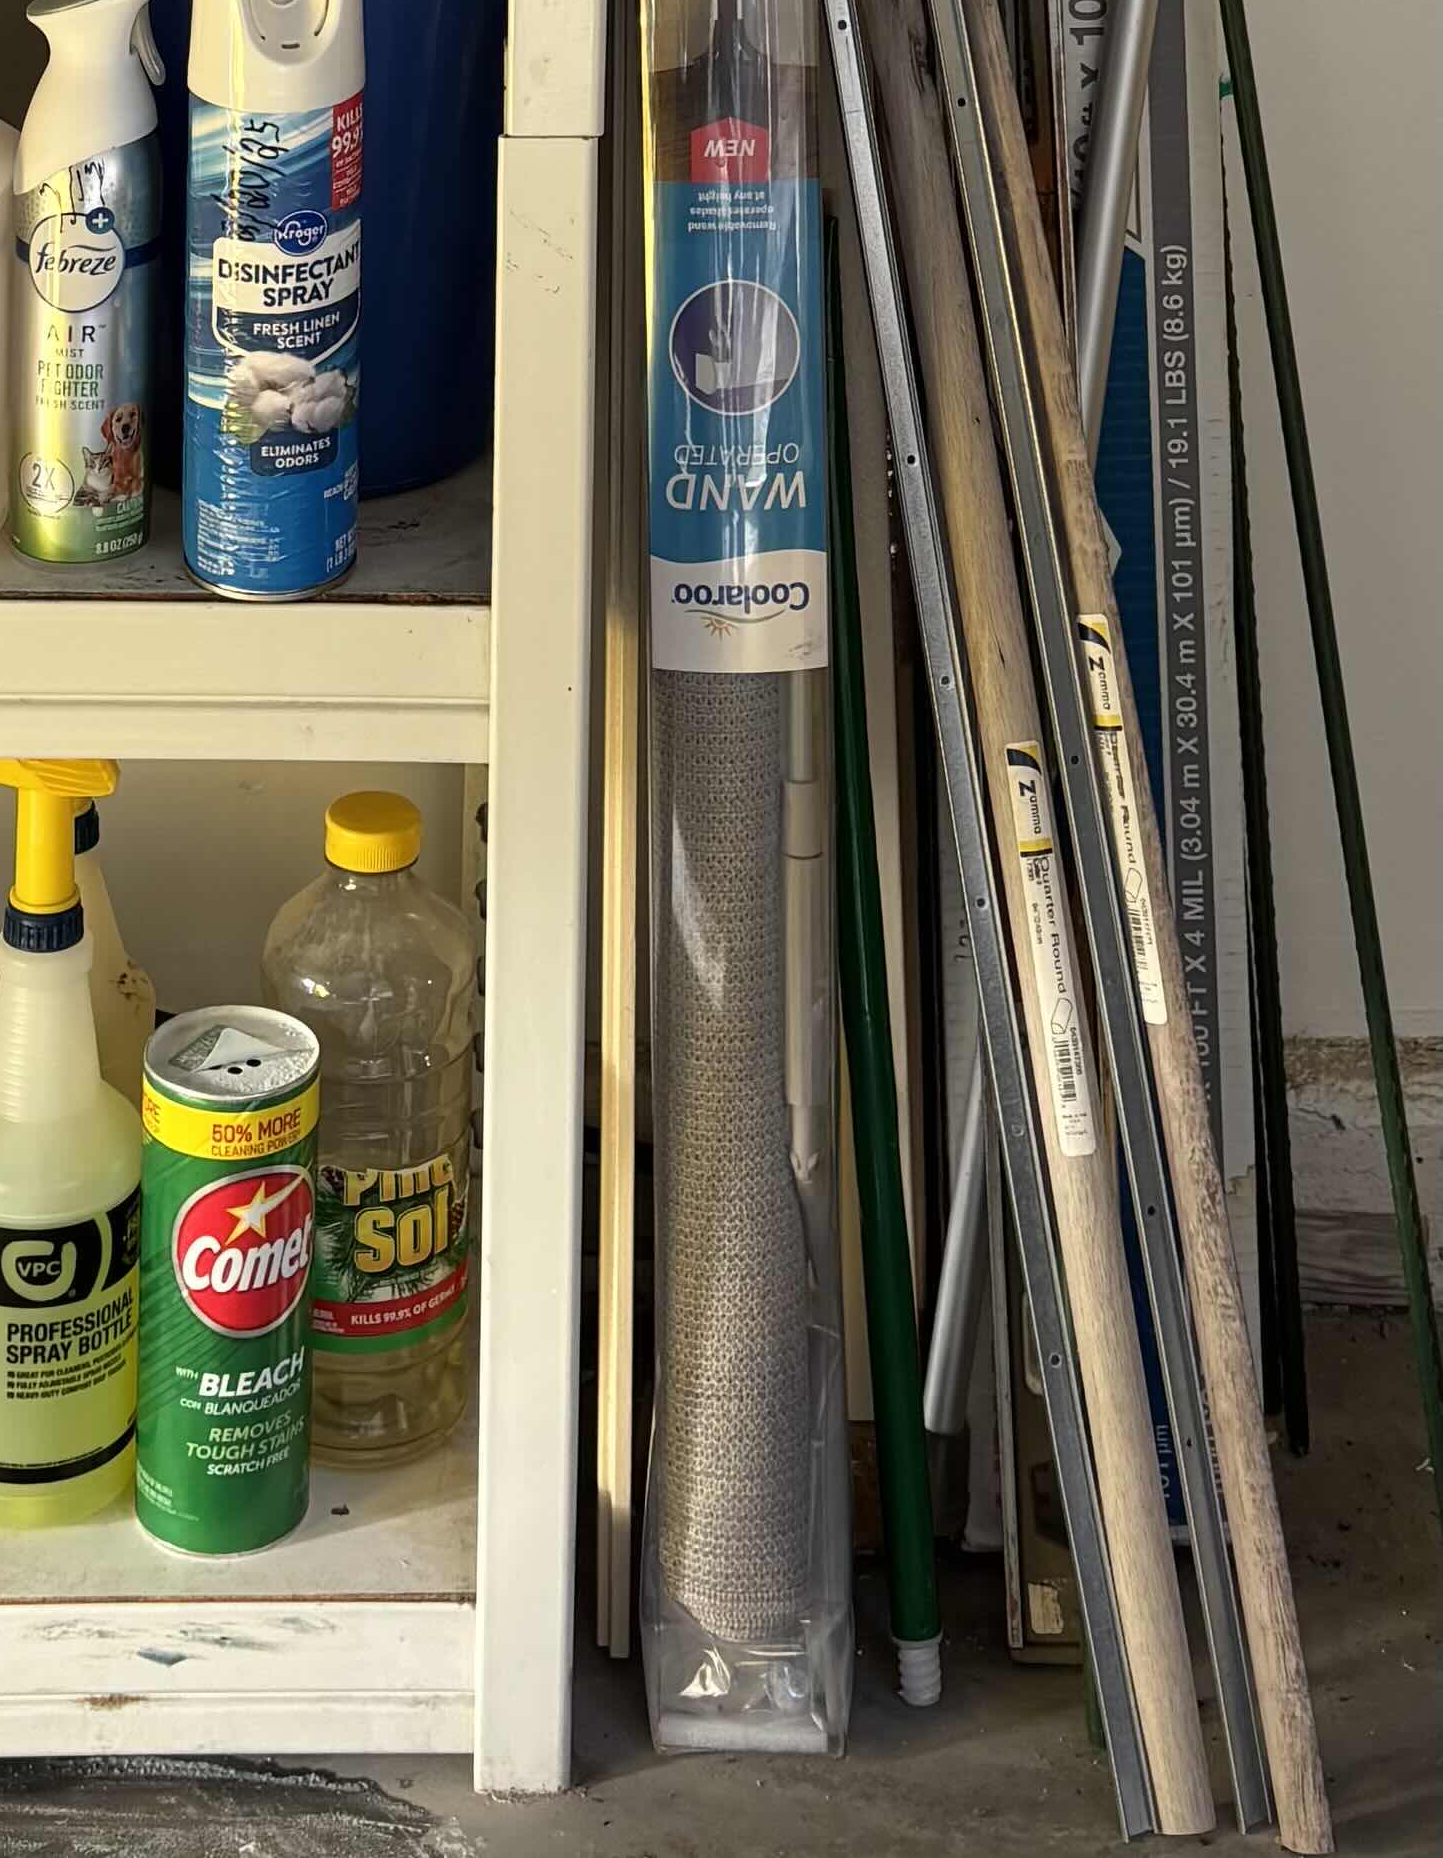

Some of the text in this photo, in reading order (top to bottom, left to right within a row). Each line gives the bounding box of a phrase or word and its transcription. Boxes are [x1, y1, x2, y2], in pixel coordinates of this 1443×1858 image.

[704, 139, 755, 158] NEW
[276, 219, 325, 247] Kroger
[35, 241, 117, 276] febreze
[1162, 241, 1187, 284] kg)
[262, 279, 334, 308] SPRAY
[47, 324, 97, 344] AIR
[252, 310, 340, 337] FRESH LINEN
[1166, 292, 1190, 344] (8.6
[276, 331, 322, 350] SCENT
[65, 363, 104, 381] ODOR
[1165, 350, 1187, 405] LBS
[261, 436, 331, 457] ELIMINATES
[1168, 417, 1189, 458] 19.1
[274, 453, 319, 469] ODORS
[674, 442, 800, 467] OPERATED
[665, 469, 807, 511] WAND
[1172, 559, 1194, 602] 101
[673, 582, 810, 616] Coolaroo
[1172, 611, 1195, 631] X
[1178, 642, 1196, 664] m
[1087, 655, 1112, 711] Zamma
[1175, 672, 1198, 729] 30.4
[1177, 736, 1199, 755] X
[1183, 766, 1200, 788] m
[1018, 779, 1043, 835] Zamma
[1179, 795, 1207, 861] (3.04
[1182, 870, 1205, 921] MIL
[1184, 929, 1206, 946] 4
[1048, 933, 1069, 994] Round
[1184, 954, 1207, 973] X
[211, 1107, 302, 1144] 50% MORE
[211, 1141, 265, 1158] CLEANING
[354, 1185, 450, 1274] Sol
[16, 1259, 62, 1278] VPC
[182, 1215, 313, 1293] Comet
[7, 1288, 134, 1344] PROFESSIONAL
[351, 1313, 381, 1325] KILLS
[383, 1308, 412, 1322] 99.9%
[412, 1300, 427, 1315] OF
[6, 1307, 133, 1365] SPRAY BOTTLE
[198, 1345, 305, 1398] BLEACH
[208, 1409, 292, 1443] REMOVES
[185, 1441, 255, 1461] TOUGH
[206, 1445, 291, 1476] SCRATCH FREE
